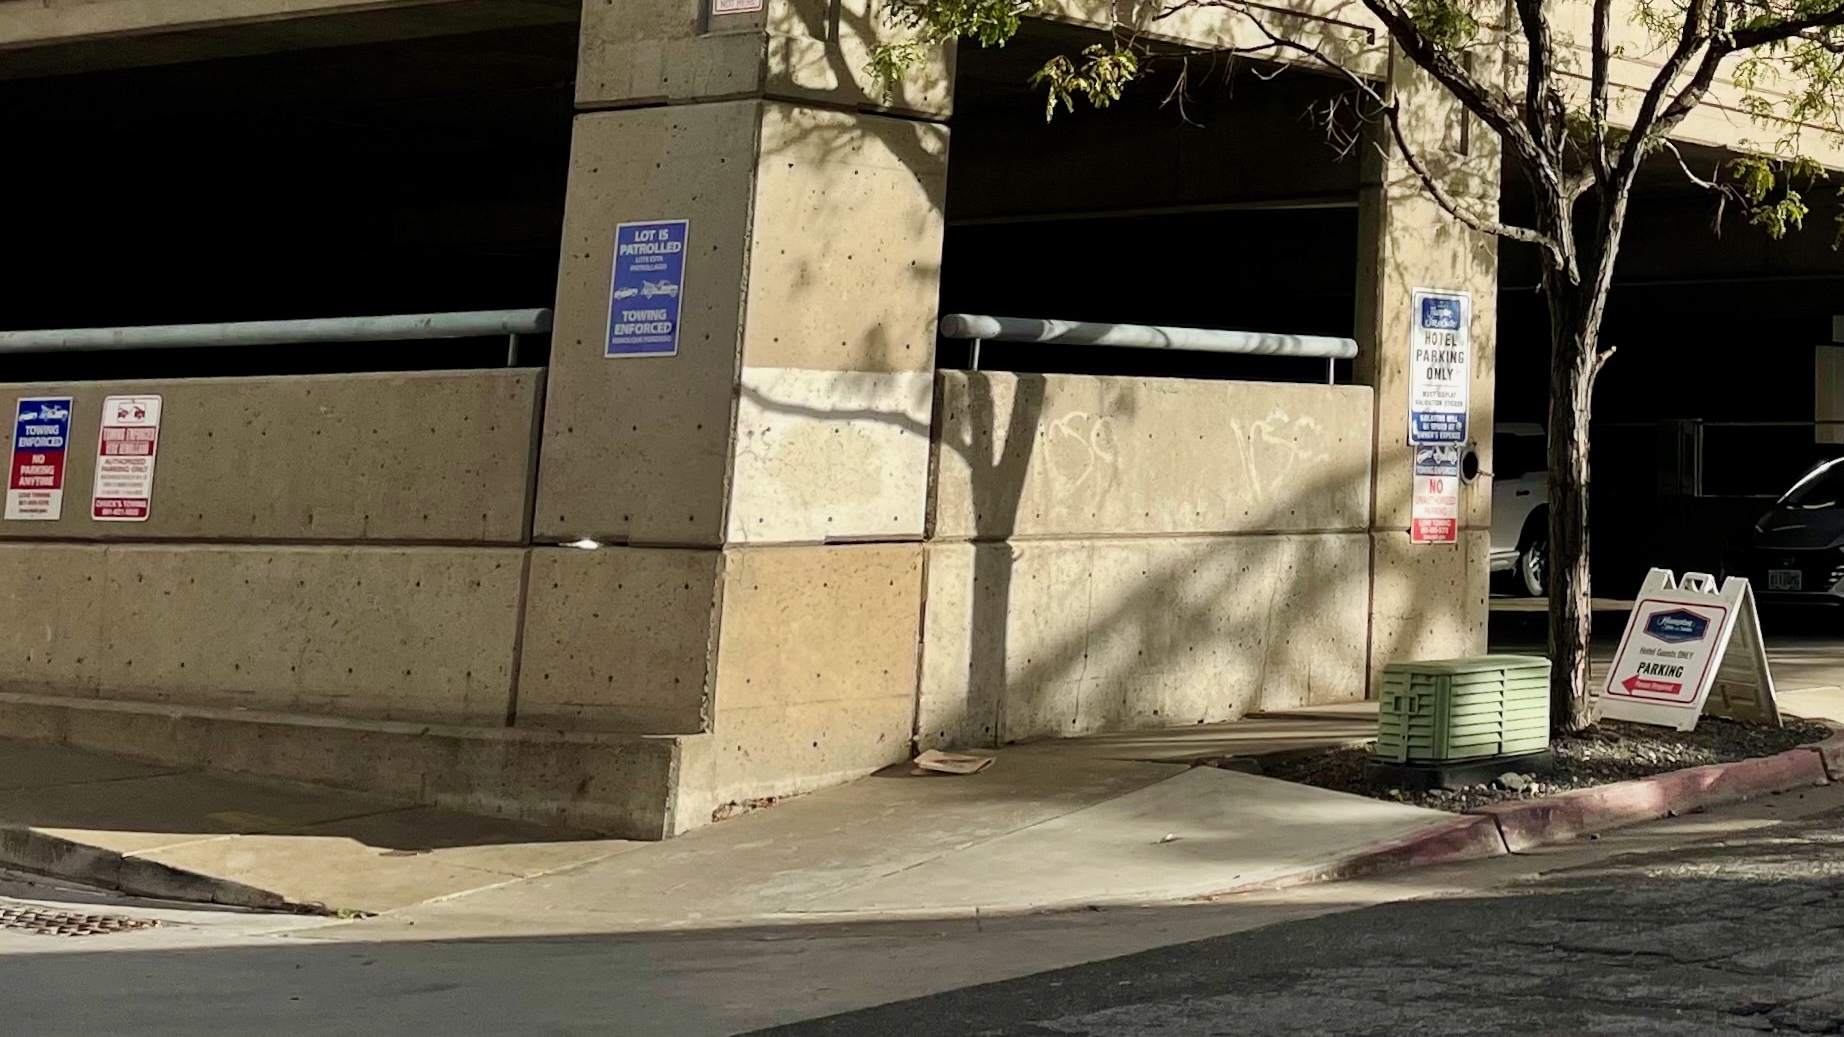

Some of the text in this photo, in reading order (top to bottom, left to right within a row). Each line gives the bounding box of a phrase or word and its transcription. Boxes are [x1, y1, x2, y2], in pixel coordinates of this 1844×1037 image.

[720, 0, 735, 8] NOT
[634, 228, 669, 242] LOT IS
[620, 241, 681, 256] PATROLLED
[622, 308, 667, 322] TOWING
[614, 322, 672, 336] ENFORCED
[1425, 331, 1457, 347] HOTEL
[1416, 349, 1464, 364] PARKING
[1426, 367, 1453, 381] ONLY
[25, 424, 60, 436] TOWING
[18, 436, 64, 448] ENFORCED
[31, 454, 46, 464] NO
[20, 465, 55, 476] PARKING
[19, 475, 55, 487] ANYTIME
[1429, 479, 1443, 494] NO
[1640, 647, 1694, 659] Hotel Guests ONLY
[1637, 662, 1684, 678] PARKING
